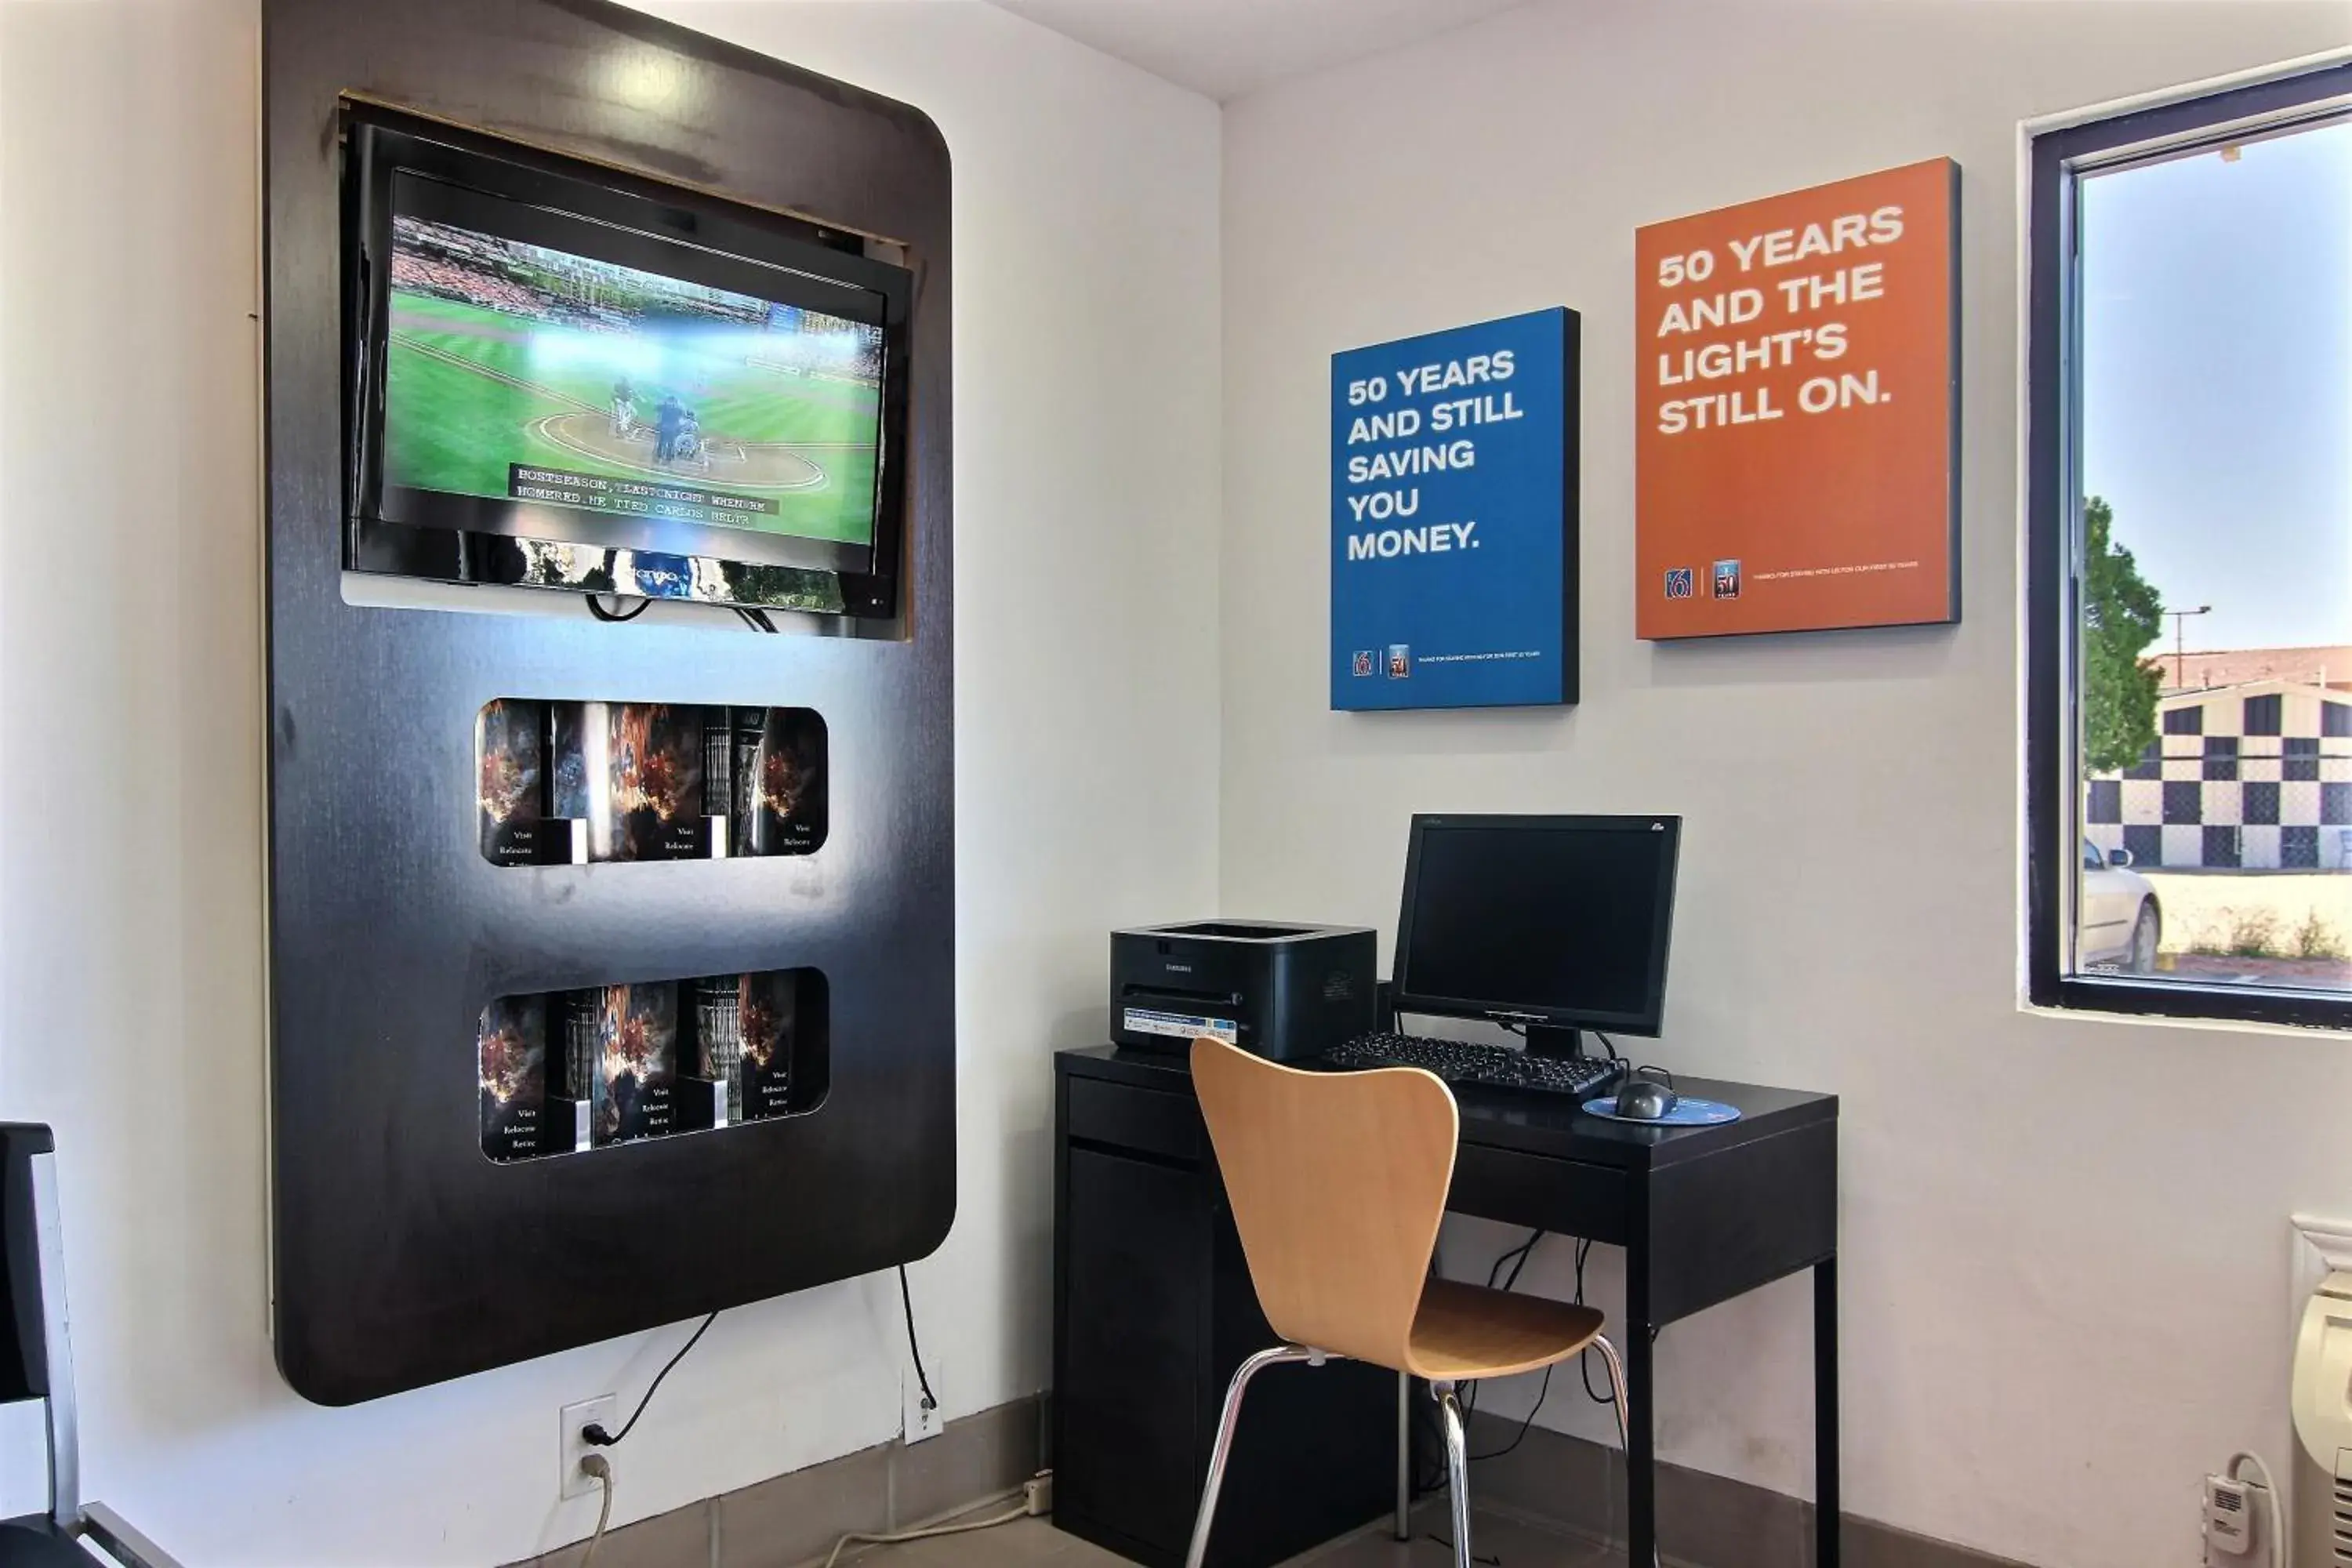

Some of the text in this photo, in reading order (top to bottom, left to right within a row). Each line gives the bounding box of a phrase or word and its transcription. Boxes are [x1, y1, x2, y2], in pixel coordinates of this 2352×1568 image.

[1657, 205, 1904, 288] 50 YEARS
[1657, 263, 1884, 337] AND THE
[1348, 350, 1515, 405] 50 YEARS
[1658, 322, 1848, 386] LIGHT'S
[1347, 392, 1523, 445] AND STILL
[1657, 369, 1891, 434] STILL ON.
[1347, 440, 1475, 483] SAVING
[711, 495, 742, 508] WHEN
[1347, 488, 1419, 521] YOU
[1347, 521, 1480, 561] MONEY.
